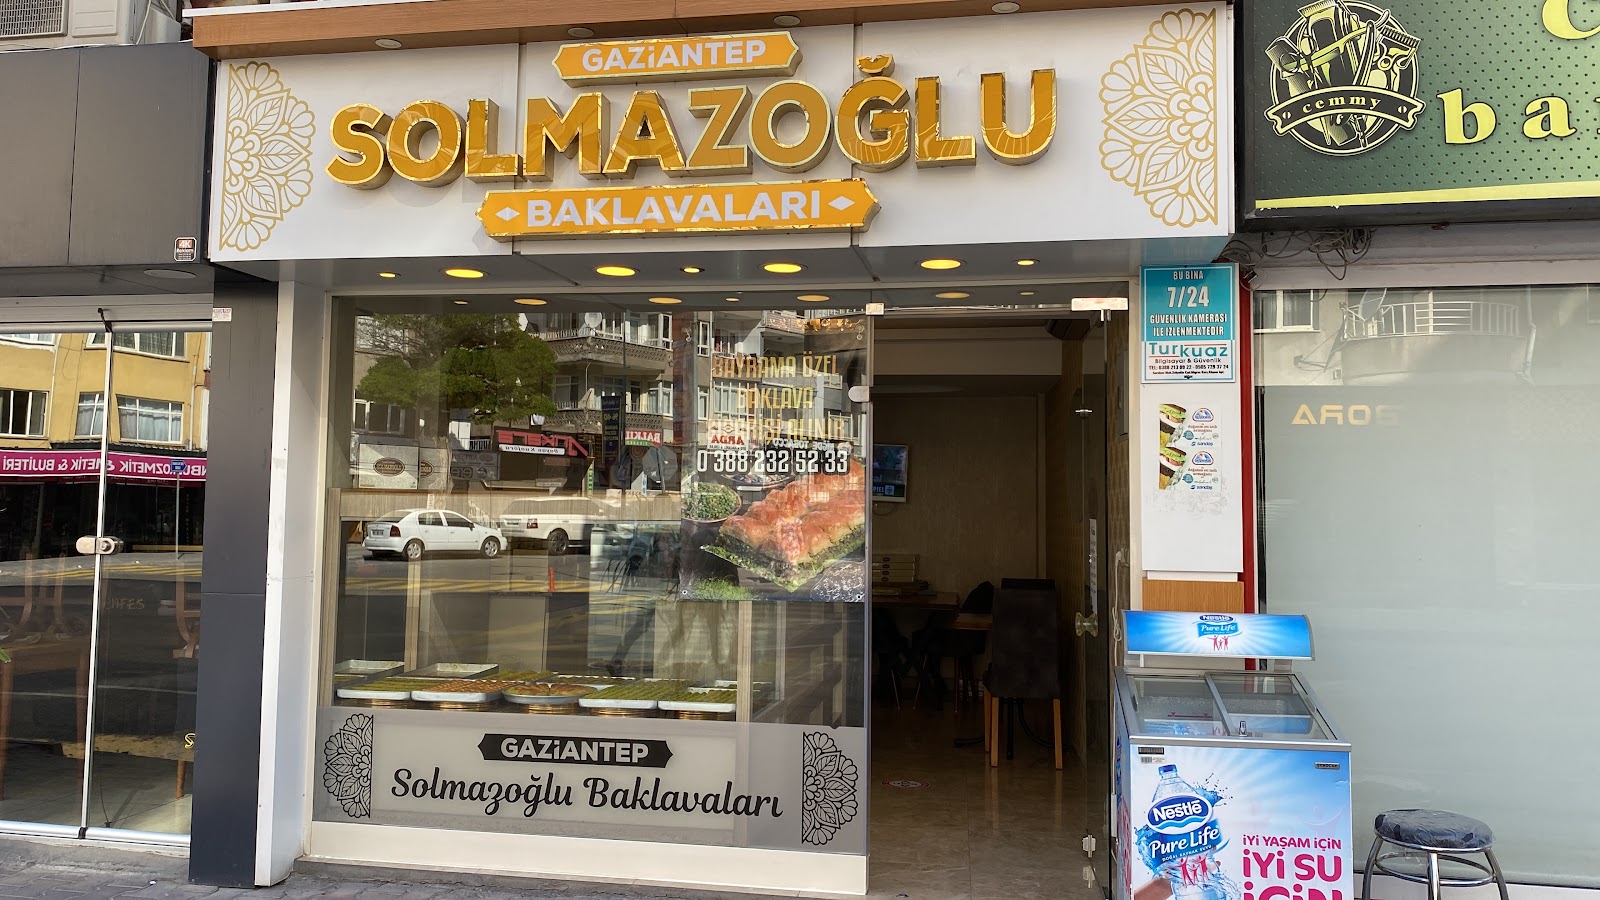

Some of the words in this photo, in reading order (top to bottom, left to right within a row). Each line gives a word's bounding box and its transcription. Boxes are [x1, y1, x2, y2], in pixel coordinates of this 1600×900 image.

[1302, 93, 1381, 115] cemmy
[325, 54, 1057, 188] SOLMAZOĞLU
[1437, 88, 1600, 145] ba
[527, 190, 820, 227] BAKLAVALARI
[179, 240, 193, 248] 4K
[1173, 271, 1184, 280] BU
[1185, 270, 1204, 280] BİNA
[1167, 285, 1210, 308] 7/24
[1149, 313, 1187, 324] GÜVENLİK
[1188, 313, 1227, 323] KAMERASI
[1153, 326, 1164, 336] İLE
[1165, 325, 1224, 336] İZLENMEKTEDİR
[1149, 342, 1228, 357] Turkuaz
[802, 351, 840, 377] ÖZEL
[697, 450, 708, 473] 0
[713, 450, 749, 473] 388
[754, 450, 789, 473] 232
[795, 450, 819, 473] 52
[824, 450, 848, 473] 33
[1201, 624, 1220, 632] Pure
[391, 766, 572, 818] Solmazoğlu
[583, 777, 784, 818] Baklavaları
[1149, 839, 1188, 859] Pure
[1190, 827, 1219, 847] Life
[1262, 835, 1310, 850] YAŞAM
[1294, 853, 1343, 882] SU
